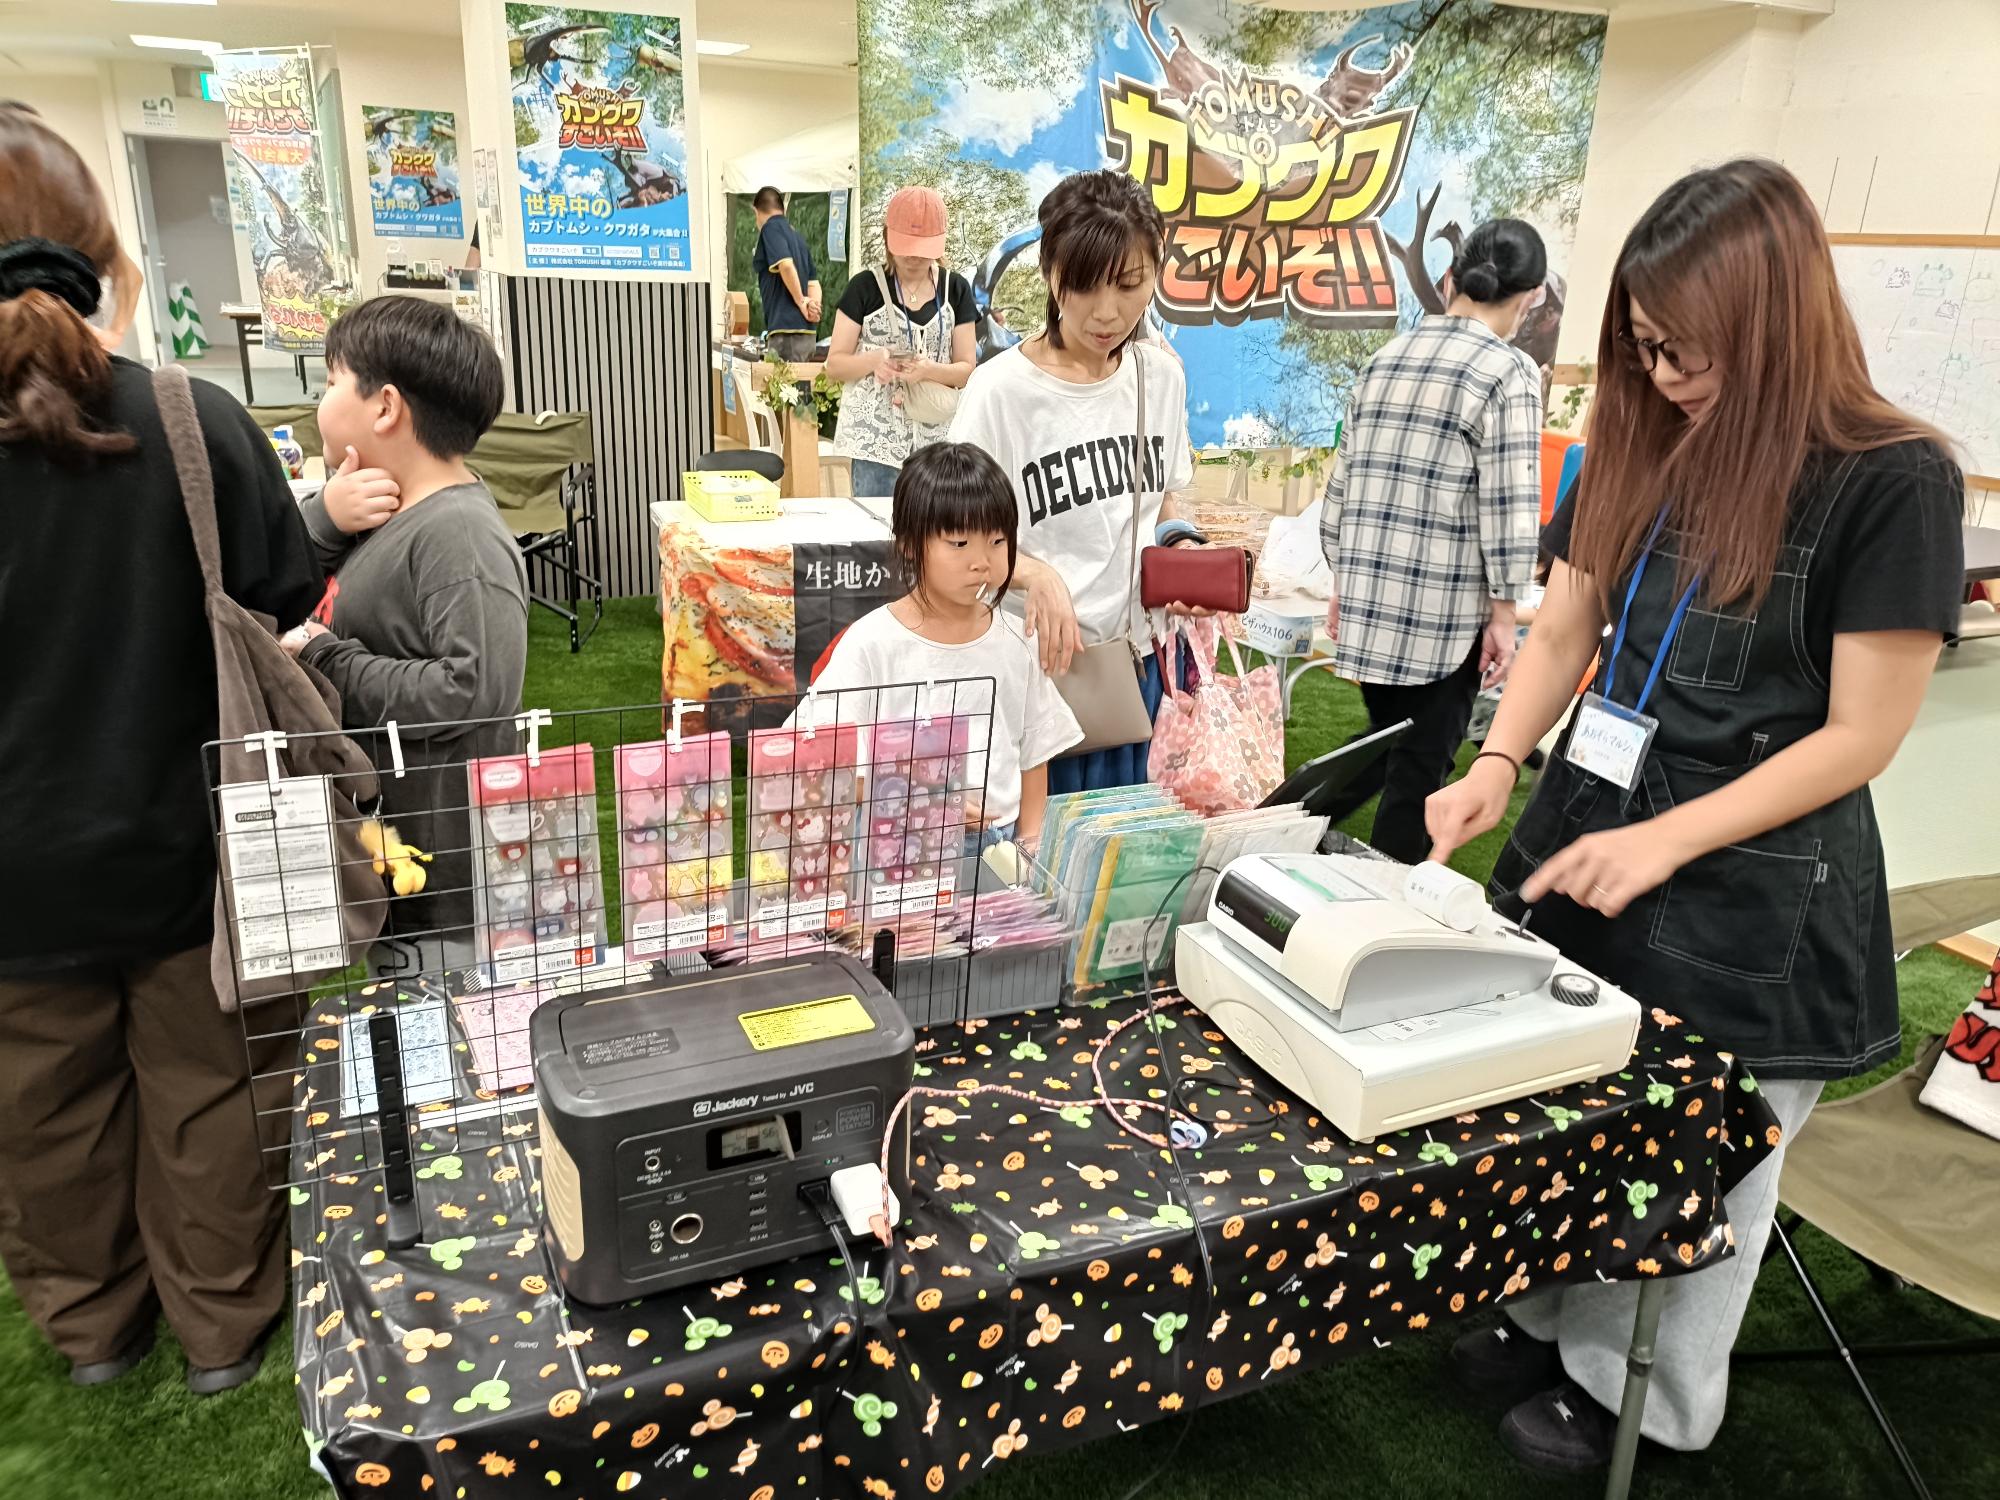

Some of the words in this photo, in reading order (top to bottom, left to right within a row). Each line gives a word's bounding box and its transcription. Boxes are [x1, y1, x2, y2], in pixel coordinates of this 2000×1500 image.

[557, 94, 644, 126] カブクワ
[1189, 73, 1343, 150] TOMUSHI
[1243, 115, 1283, 135] トムシ
[1110, 91, 1403, 222] カブクワ
[1248, 133, 1277, 165] の
[526, 194, 612, 218] 世界中の
[1162, 224, 1394, 306] ごいぞ!!
[1021, 434, 1166, 527] DECIDING
[1218, 901, 1234, 916] CASIO
[1264, 907, 1291, 933] 300
[712, 1094, 760, 1113] Jackery
[790, 1082, 815, 1097] JVC
